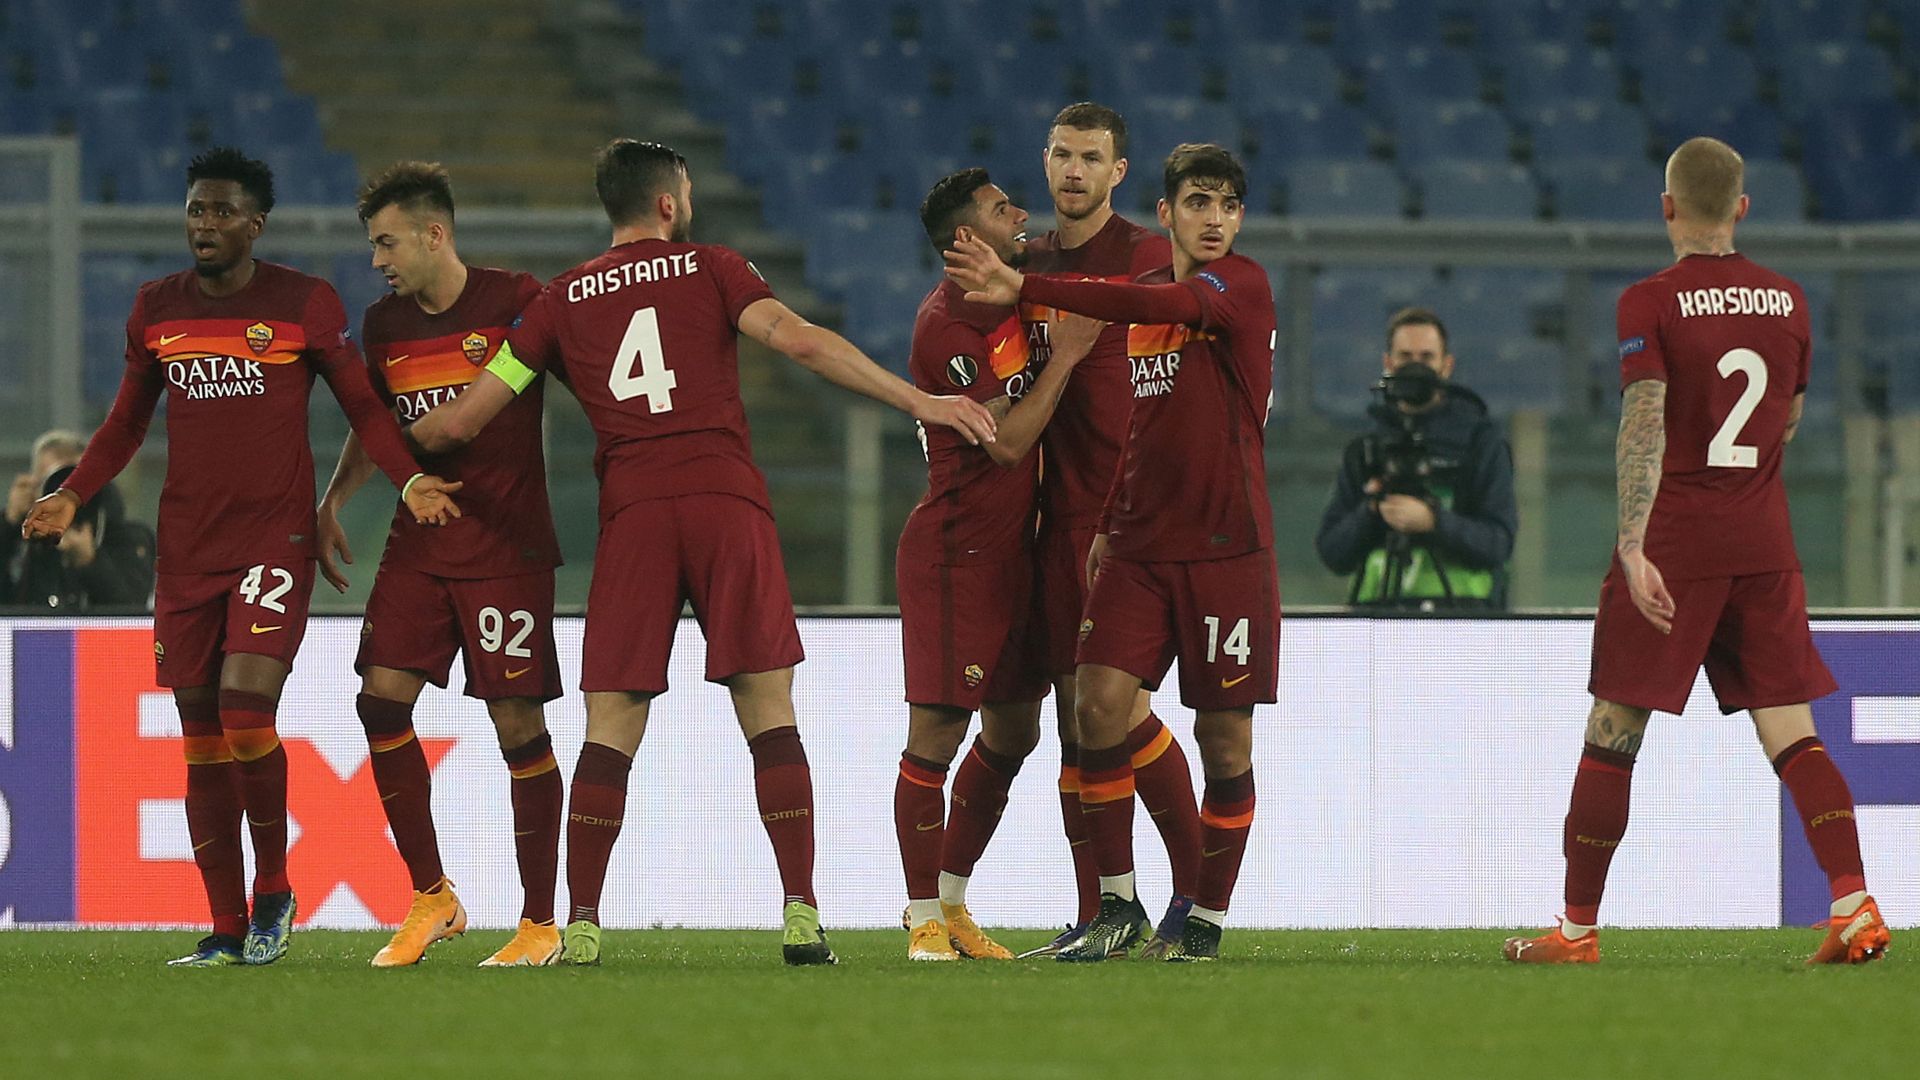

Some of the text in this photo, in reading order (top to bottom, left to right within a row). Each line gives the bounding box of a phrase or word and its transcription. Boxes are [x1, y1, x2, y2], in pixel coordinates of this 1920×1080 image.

[567, 250, 699, 303] CRISTANTE
[1676, 286, 1794, 318] KARSDORP
[168, 356, 264, 389] QATAR
[608, 306, 678, 414] 4
[1128, 352, 1181, 386] AAR
[187, 379, 265, 400] AIRWAYS
[396, 385, 471, 420] QAT
[1706, 347, 1769, 468] 2
[239, 564, 294, 614] 42
[478, 606, 535, 658] 92
[1204, 615, 1251, 666] 14
[1576, 835, 1618, 848] ROM
